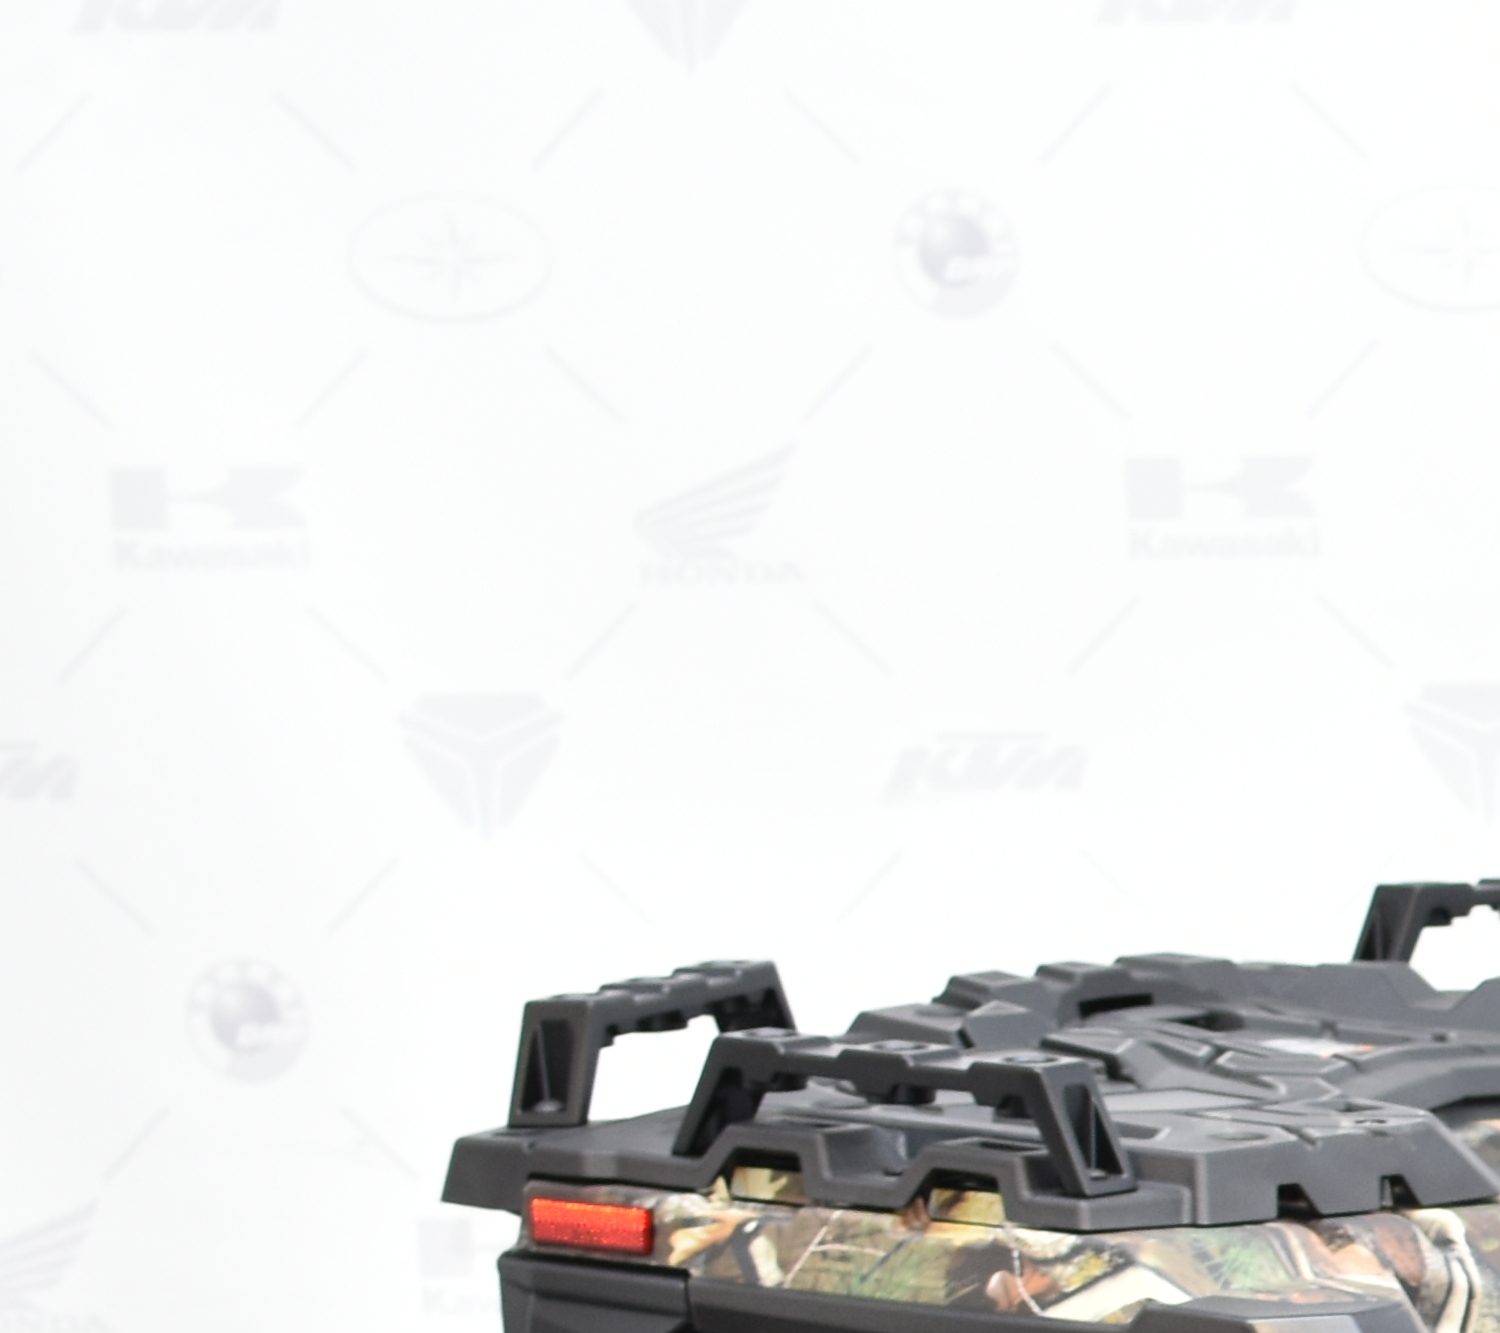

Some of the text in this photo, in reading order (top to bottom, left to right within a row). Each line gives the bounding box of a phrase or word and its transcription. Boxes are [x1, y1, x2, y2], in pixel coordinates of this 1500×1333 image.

[111, 539, 311, 571] Kawasaki
[1126, 529, 1322, 561] Kawasaki
[883, 730, 1089, 803] KTM
